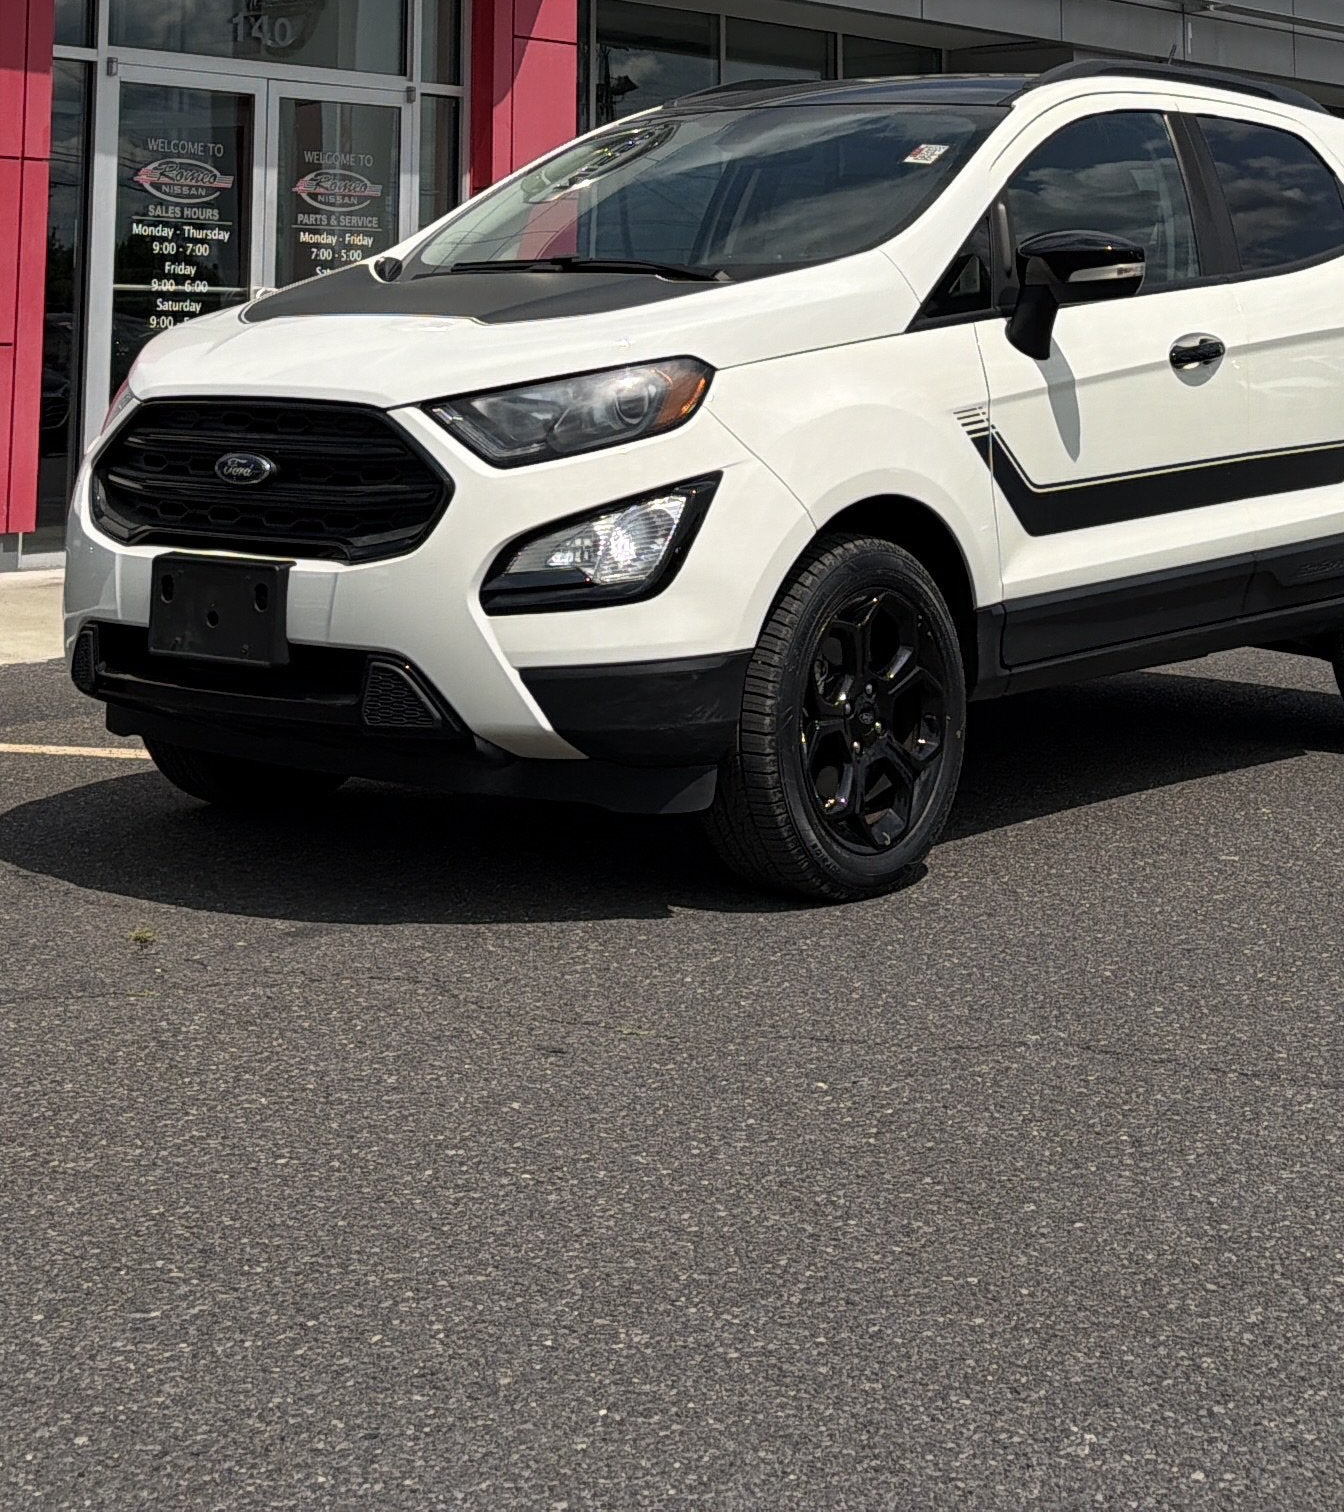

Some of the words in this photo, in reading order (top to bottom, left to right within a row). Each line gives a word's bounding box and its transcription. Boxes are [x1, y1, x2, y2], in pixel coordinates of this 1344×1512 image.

[147, 138, 205, 155] WELCOME
[208, 143, 224, 157] TO
[304, 150, 356, 166] WELCOME
[359, 154, 373, 167] TO
[152, 161, 218, 185] Romeo
[161, 185, 206, 196] NISSAN
[312, 174, 368, 193] Romeo
[317, 195, 358, 204] NISSAN
[148, 204, 182, 218] SALES
[183, 207, 220, 220] HOURS
[297, 213, 328, 225] PARTS
[329, 215, 337, 226] &
[339, 215, 379, 228] SERVICE
[132, 223, 174, 239] Monday
[182, 225, 231, 243] Thursday
[299, 231, 337, 246] Monday
[345, 233, 374, 248] Friday
[152, 241, 177, 255] 9:00
[185, 243, 210, 256] 7:00
[310, 248, 333, 261] 7:00
[341, 249, 363, 262] 5:00
[164, 261, 197, 277] Friday
[151, 279, 176, 292] 9:00
[184, 280, 209, 292] 6:00
[156, 298, 202, 314] Saturday
[149, 316, 174, 329] 9:00
[223, 457, 255, 477] Ford
